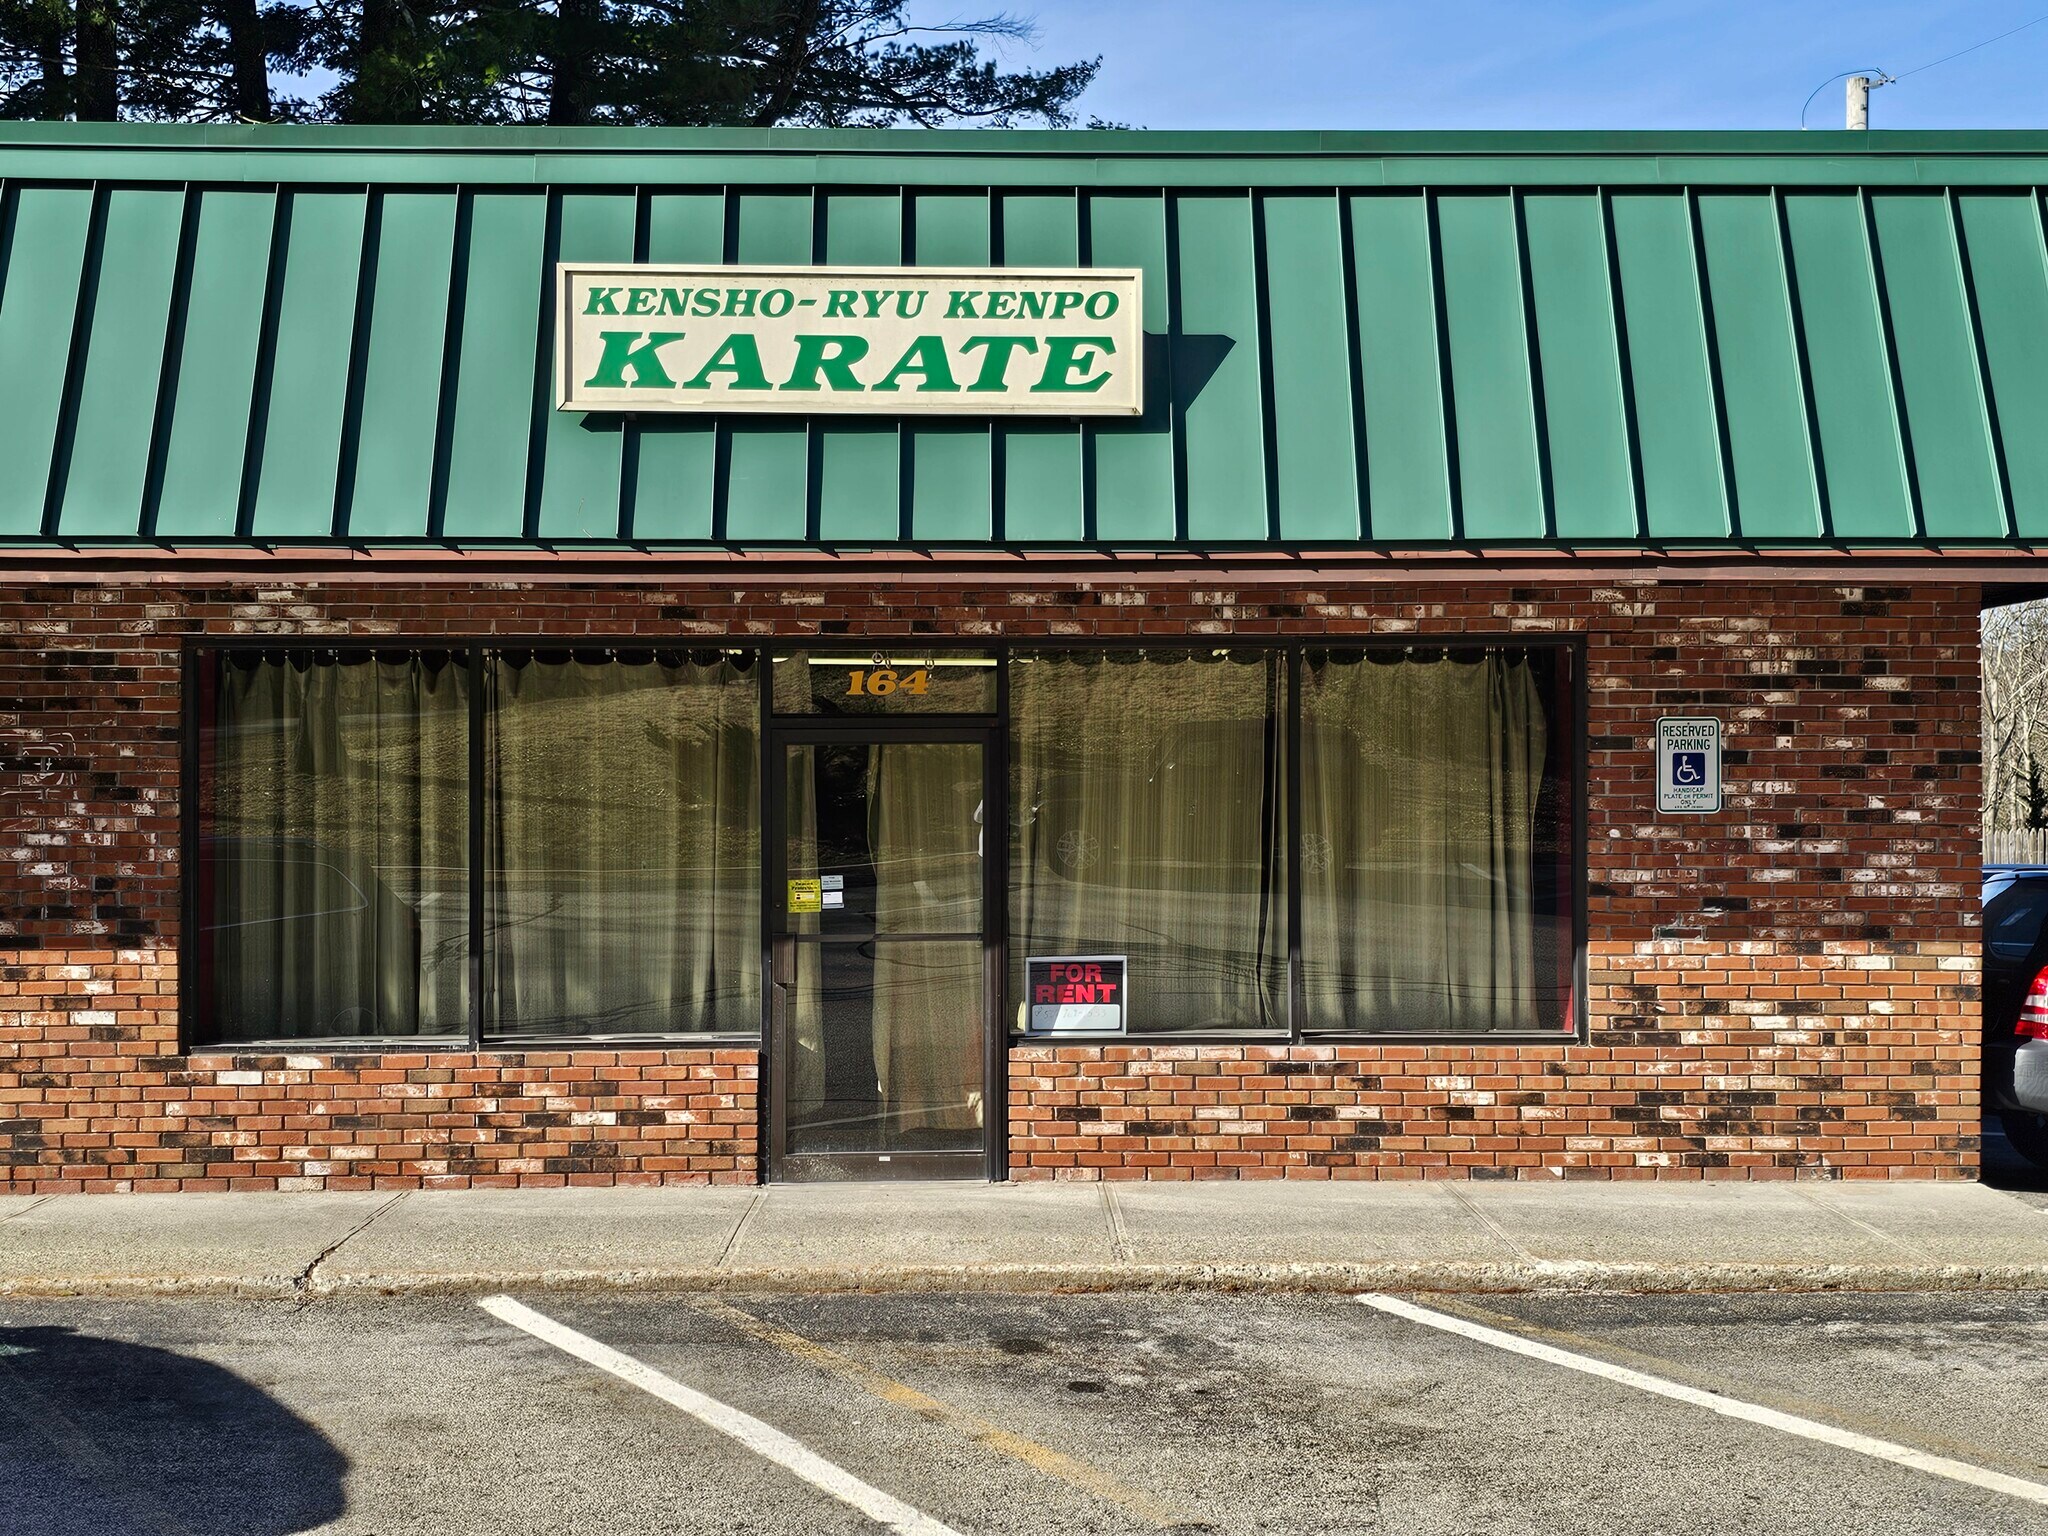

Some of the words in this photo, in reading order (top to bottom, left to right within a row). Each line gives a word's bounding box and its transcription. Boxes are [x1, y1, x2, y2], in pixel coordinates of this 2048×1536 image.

[582, 287, 929, 319] KENSHO-RYU
[943, 291, 1120, 320] KENPO
[583, 331, 1117, 393] KARATE
[846, 670, 928, 695] 164
[1662, 725, 1715, 737] RESERVED
[1667, 739, 1711, 750] PARKING
[1050, 963, 1102, 983] FOR
[1036, 984, 1116, 1003] RENT
